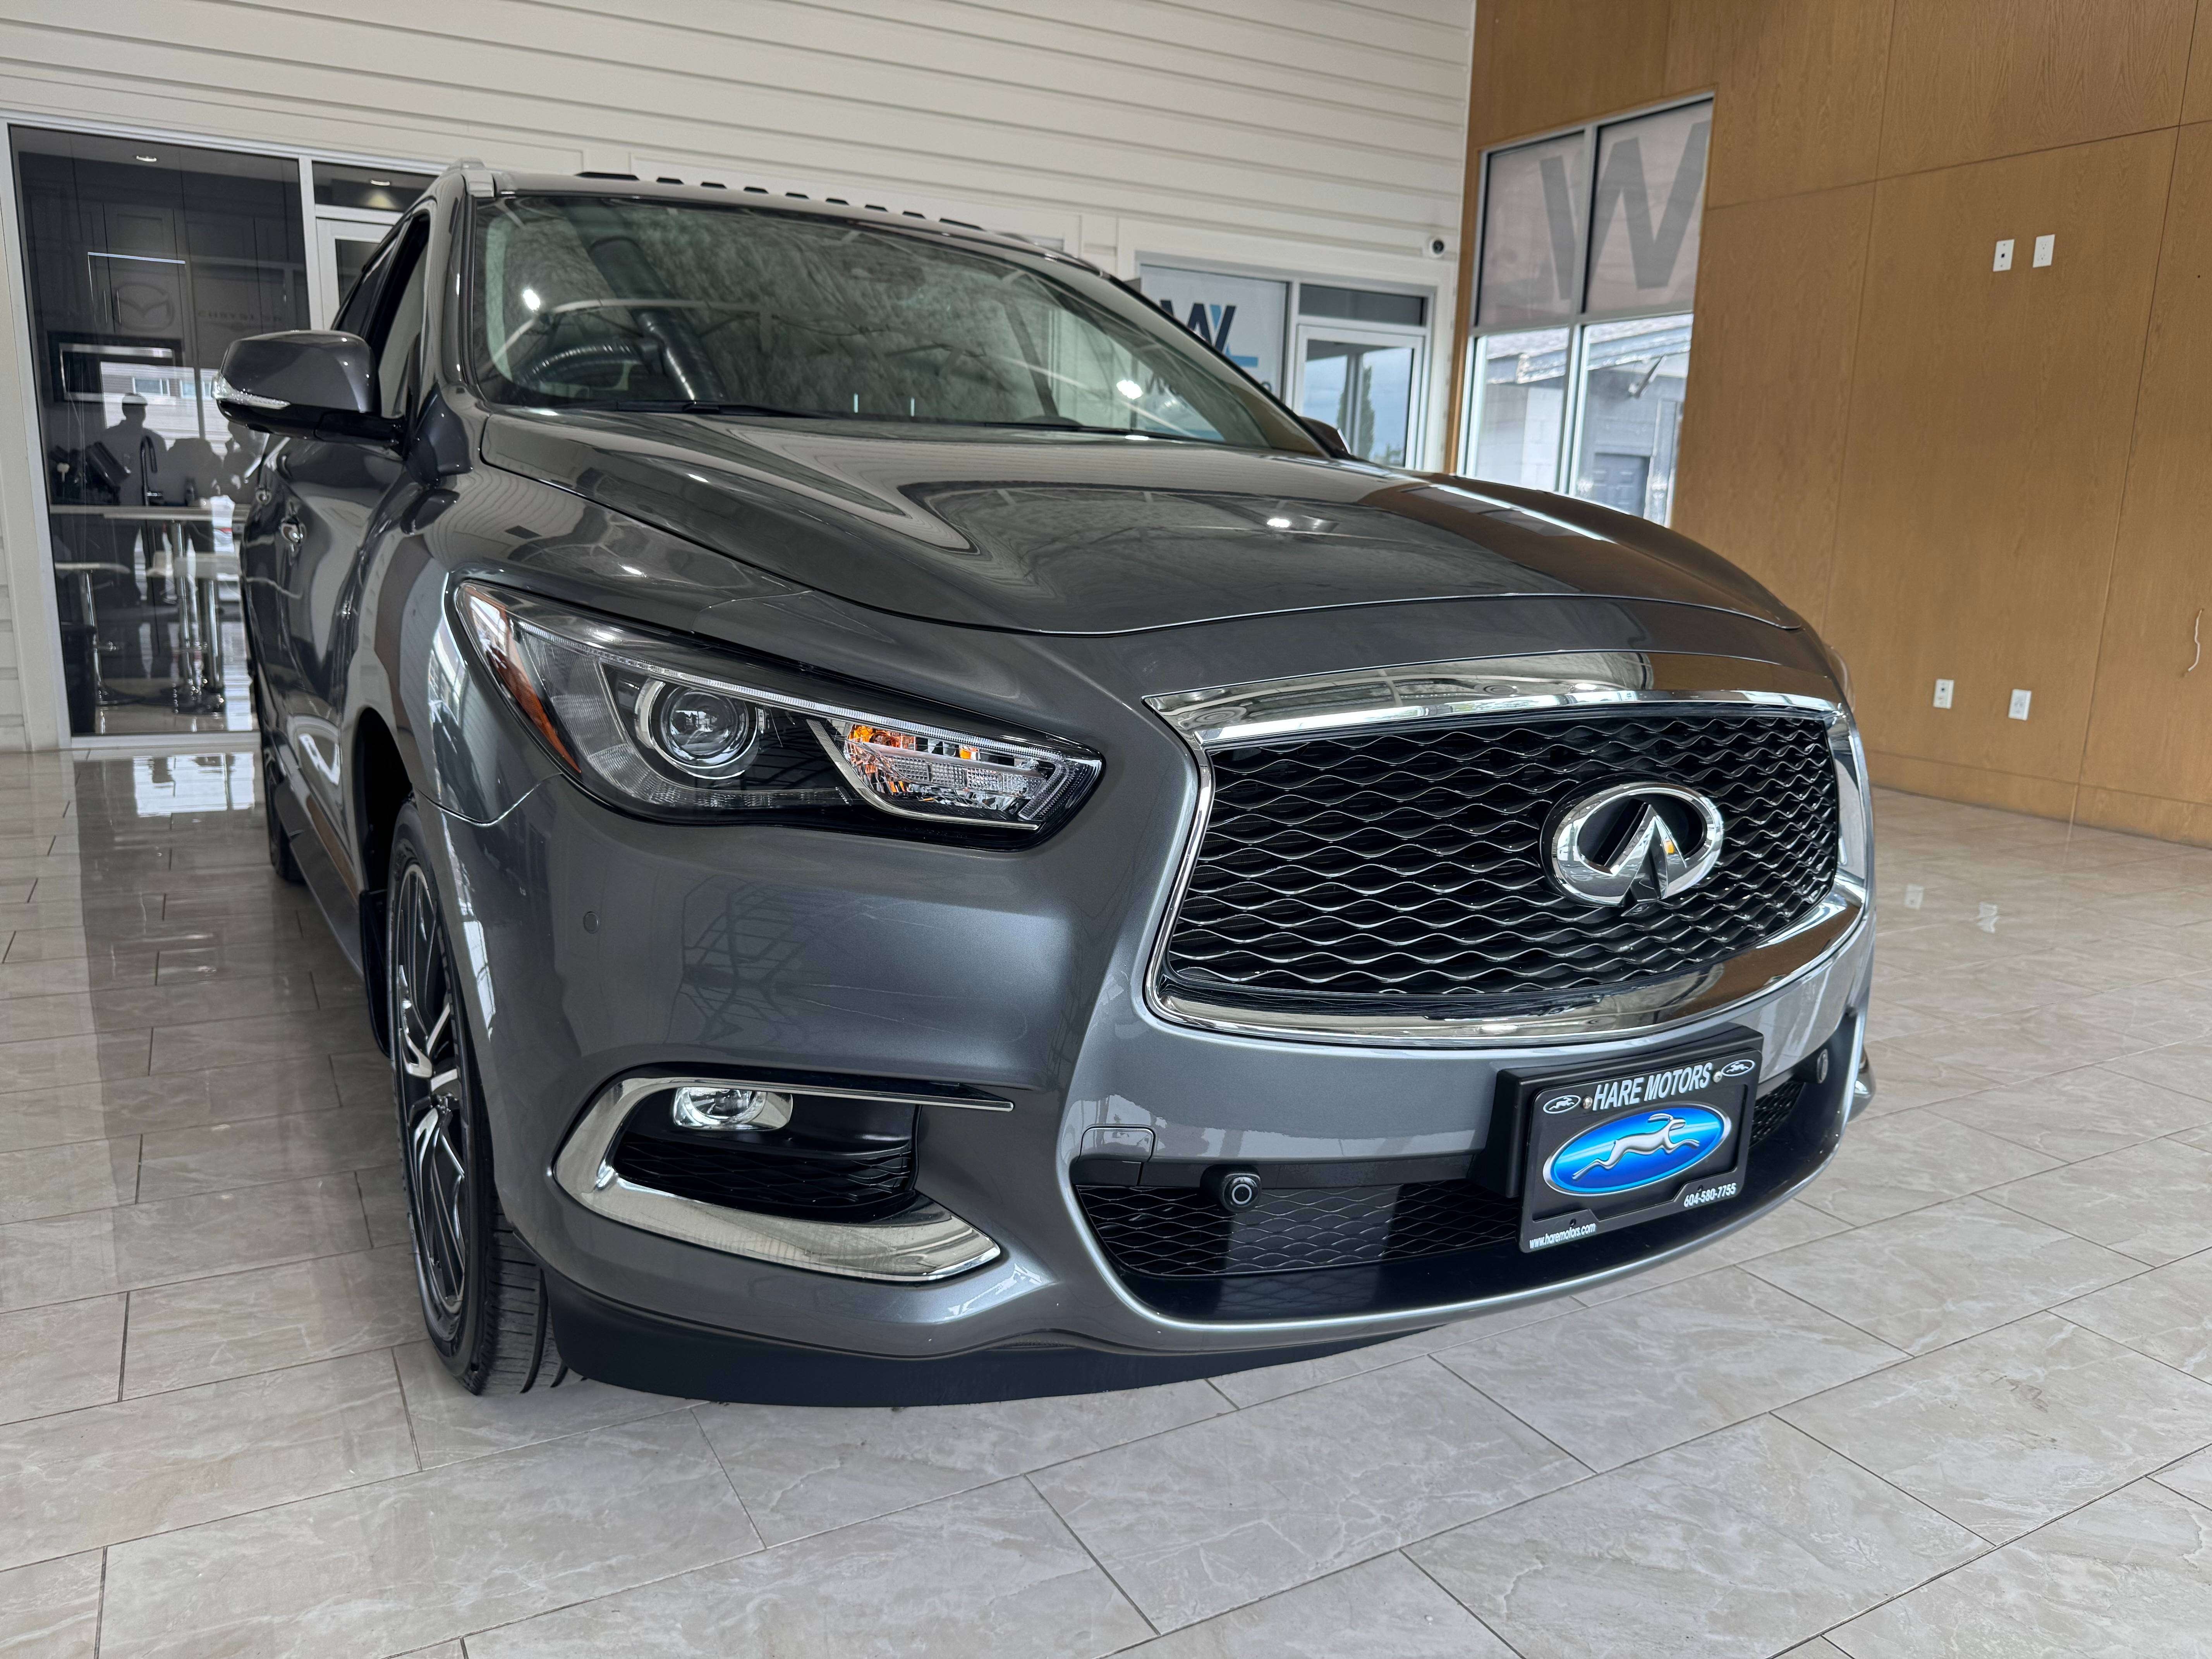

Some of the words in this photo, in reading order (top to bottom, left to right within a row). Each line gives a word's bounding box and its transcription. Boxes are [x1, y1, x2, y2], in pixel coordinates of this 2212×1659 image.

[1592, 1077, 1644, 1111] HARE
[1644, 1062, 1712, 1101] MOTORS
[1684, 1183, 1736, 1207] 604-580-7755
[1529, 1223, 1596, 1249] www.haremotors.com
